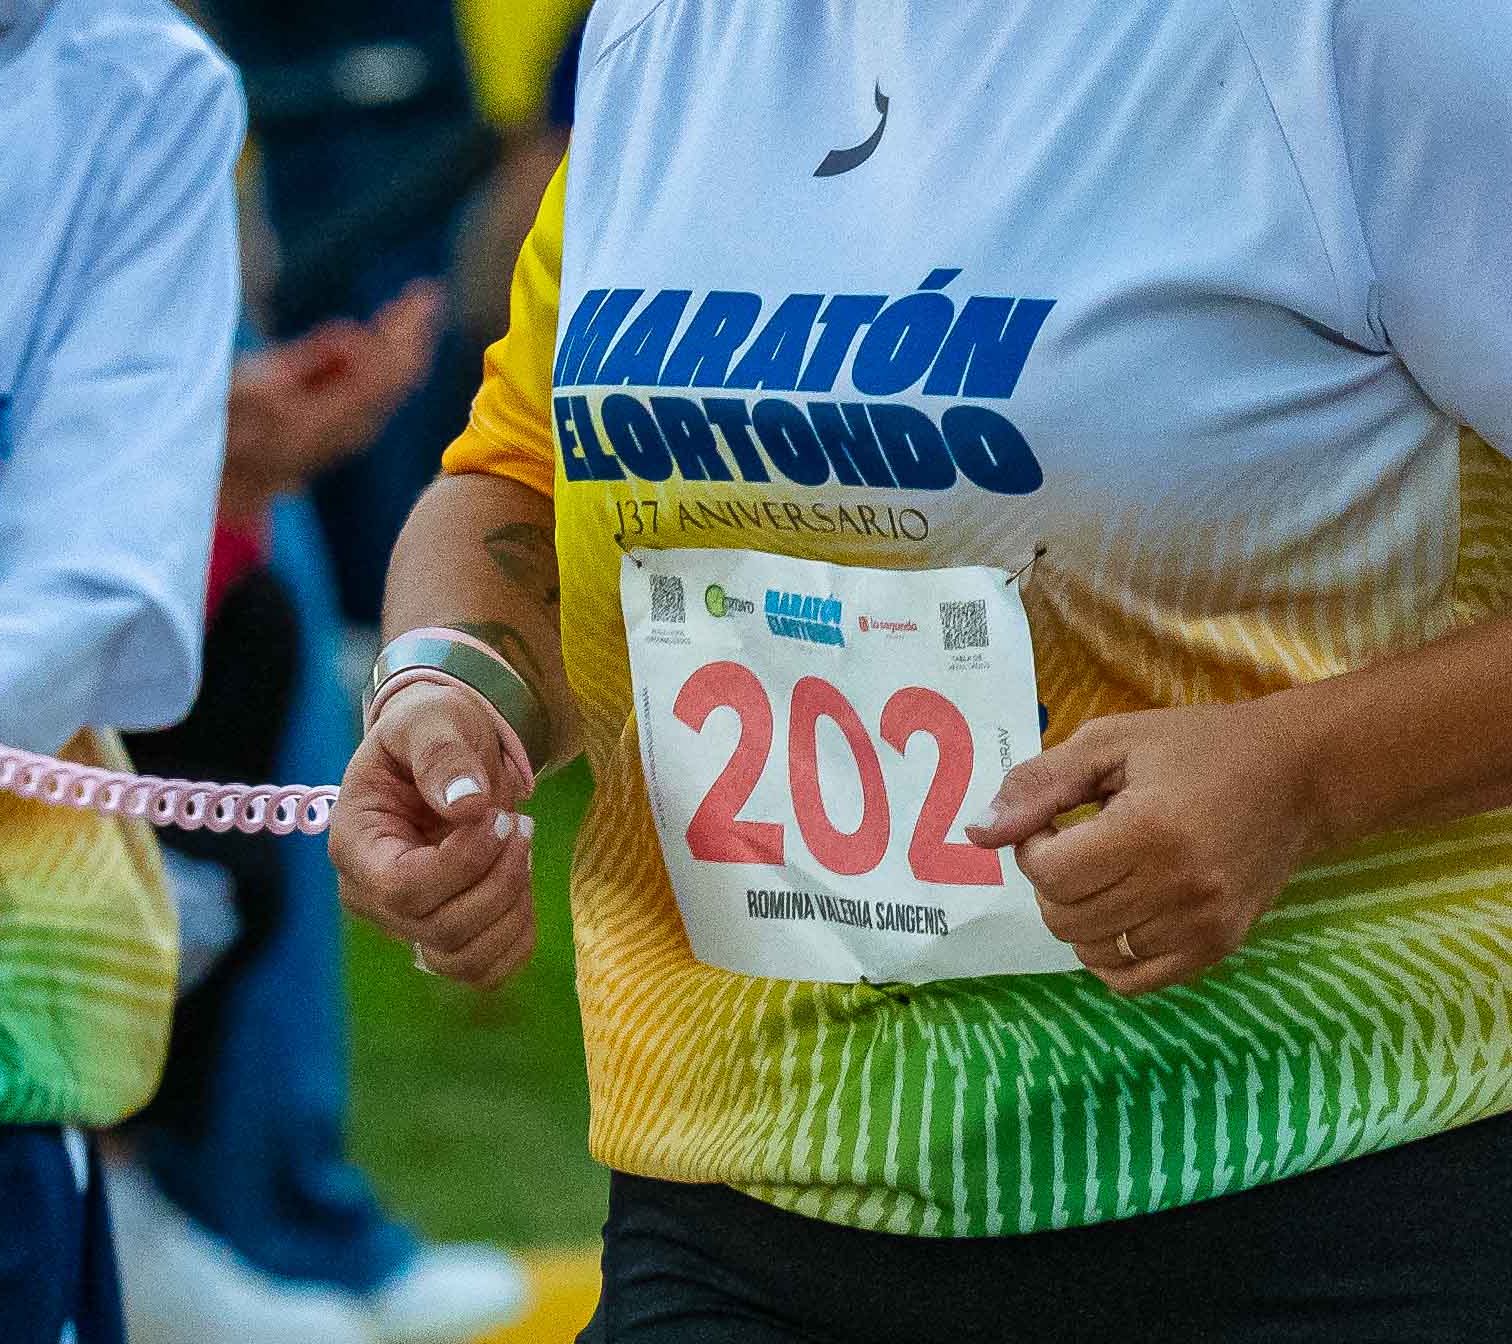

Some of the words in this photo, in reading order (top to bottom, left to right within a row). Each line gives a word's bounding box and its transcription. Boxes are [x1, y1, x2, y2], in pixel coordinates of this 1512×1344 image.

[553, 268, 1057, 399] MARATÓN
[553, 392, 1044, 496] ELORTONDO
[678, 500, 929, 541] ANIVERSARIO
[672, 660, 1004, 886] 202
[747, 889, 816, 920] ROMINA
[815, 894, 873, 929] VALERIA
[876, 902, 949, 936] SANGENIS
